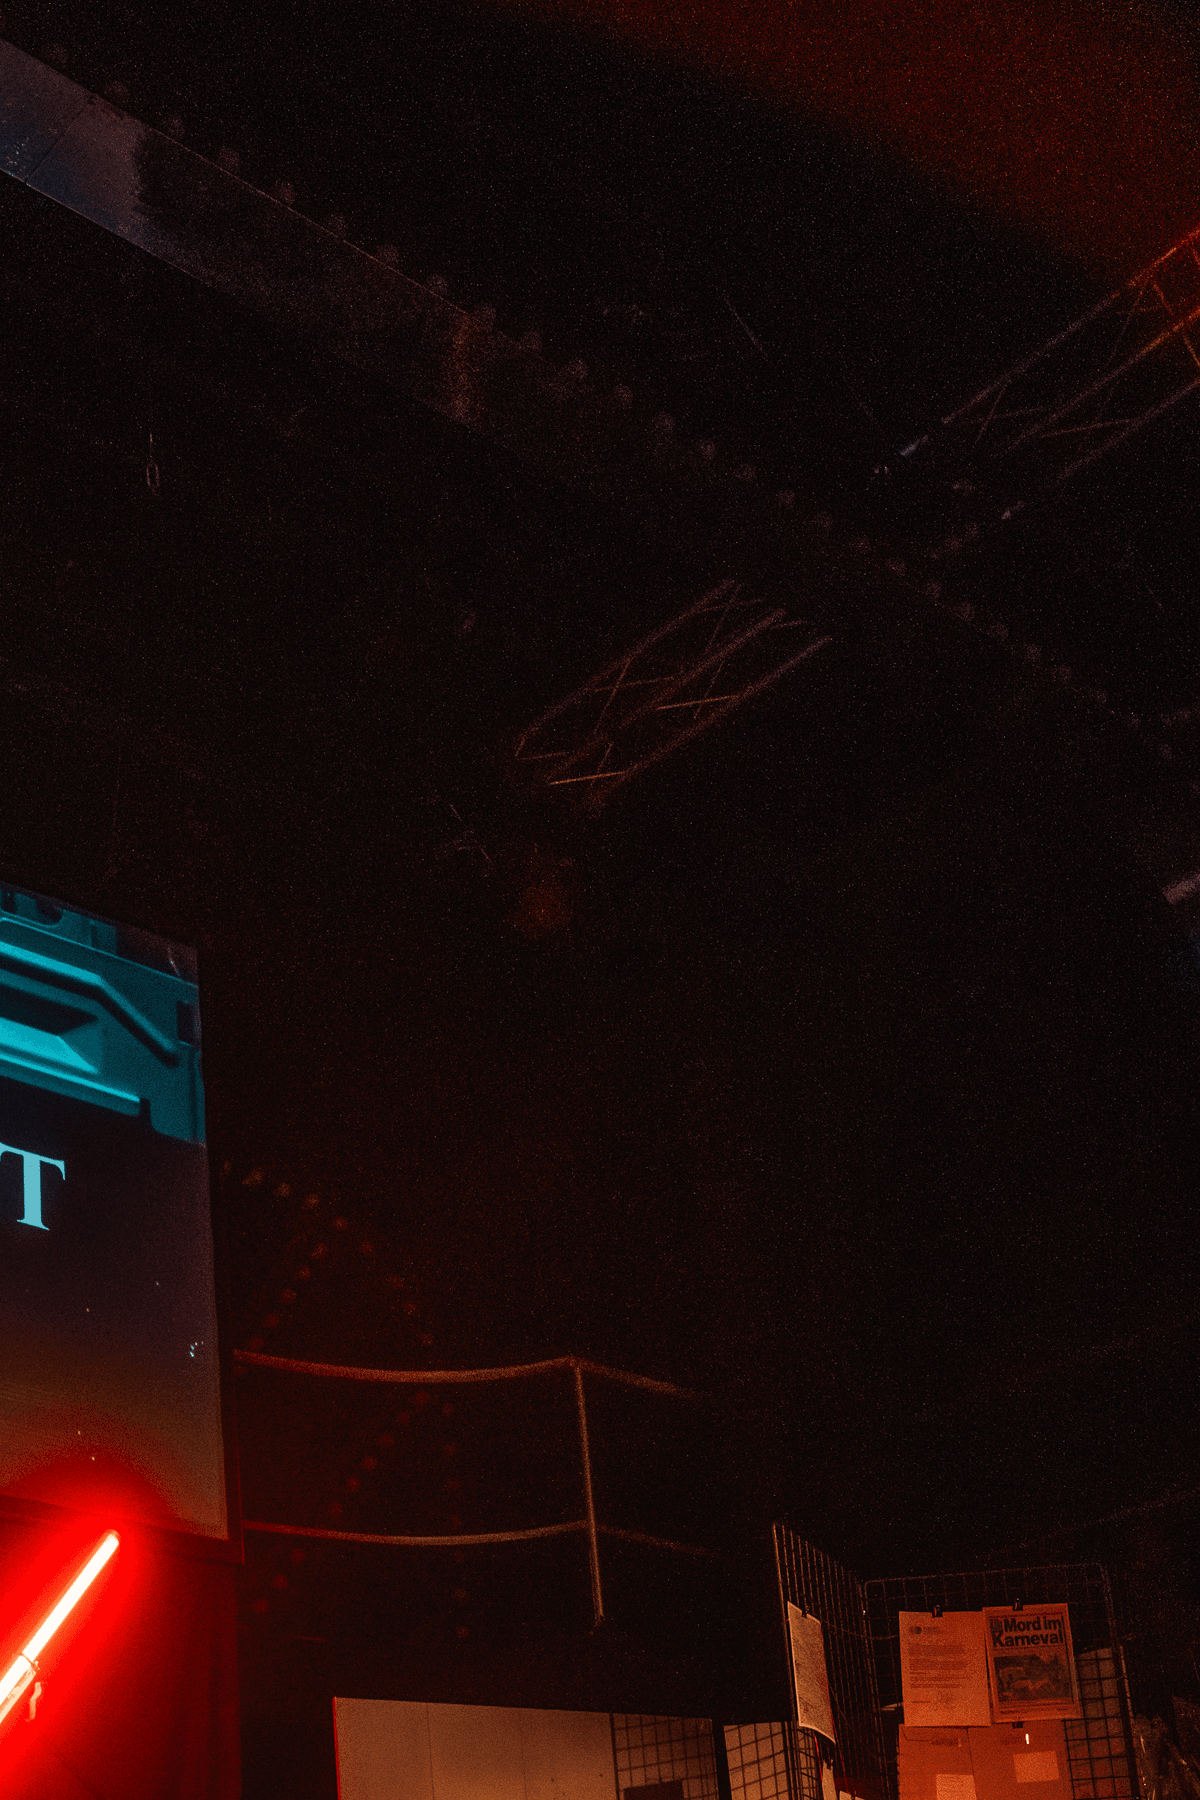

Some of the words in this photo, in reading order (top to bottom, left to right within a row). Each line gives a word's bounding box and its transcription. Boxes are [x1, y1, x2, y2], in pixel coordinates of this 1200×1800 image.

[1003, 1616, 1042, 1633] Mord
[1043, 1616, 1062, 1631] im
[993, 1629, 1064, 1648] Karneval
